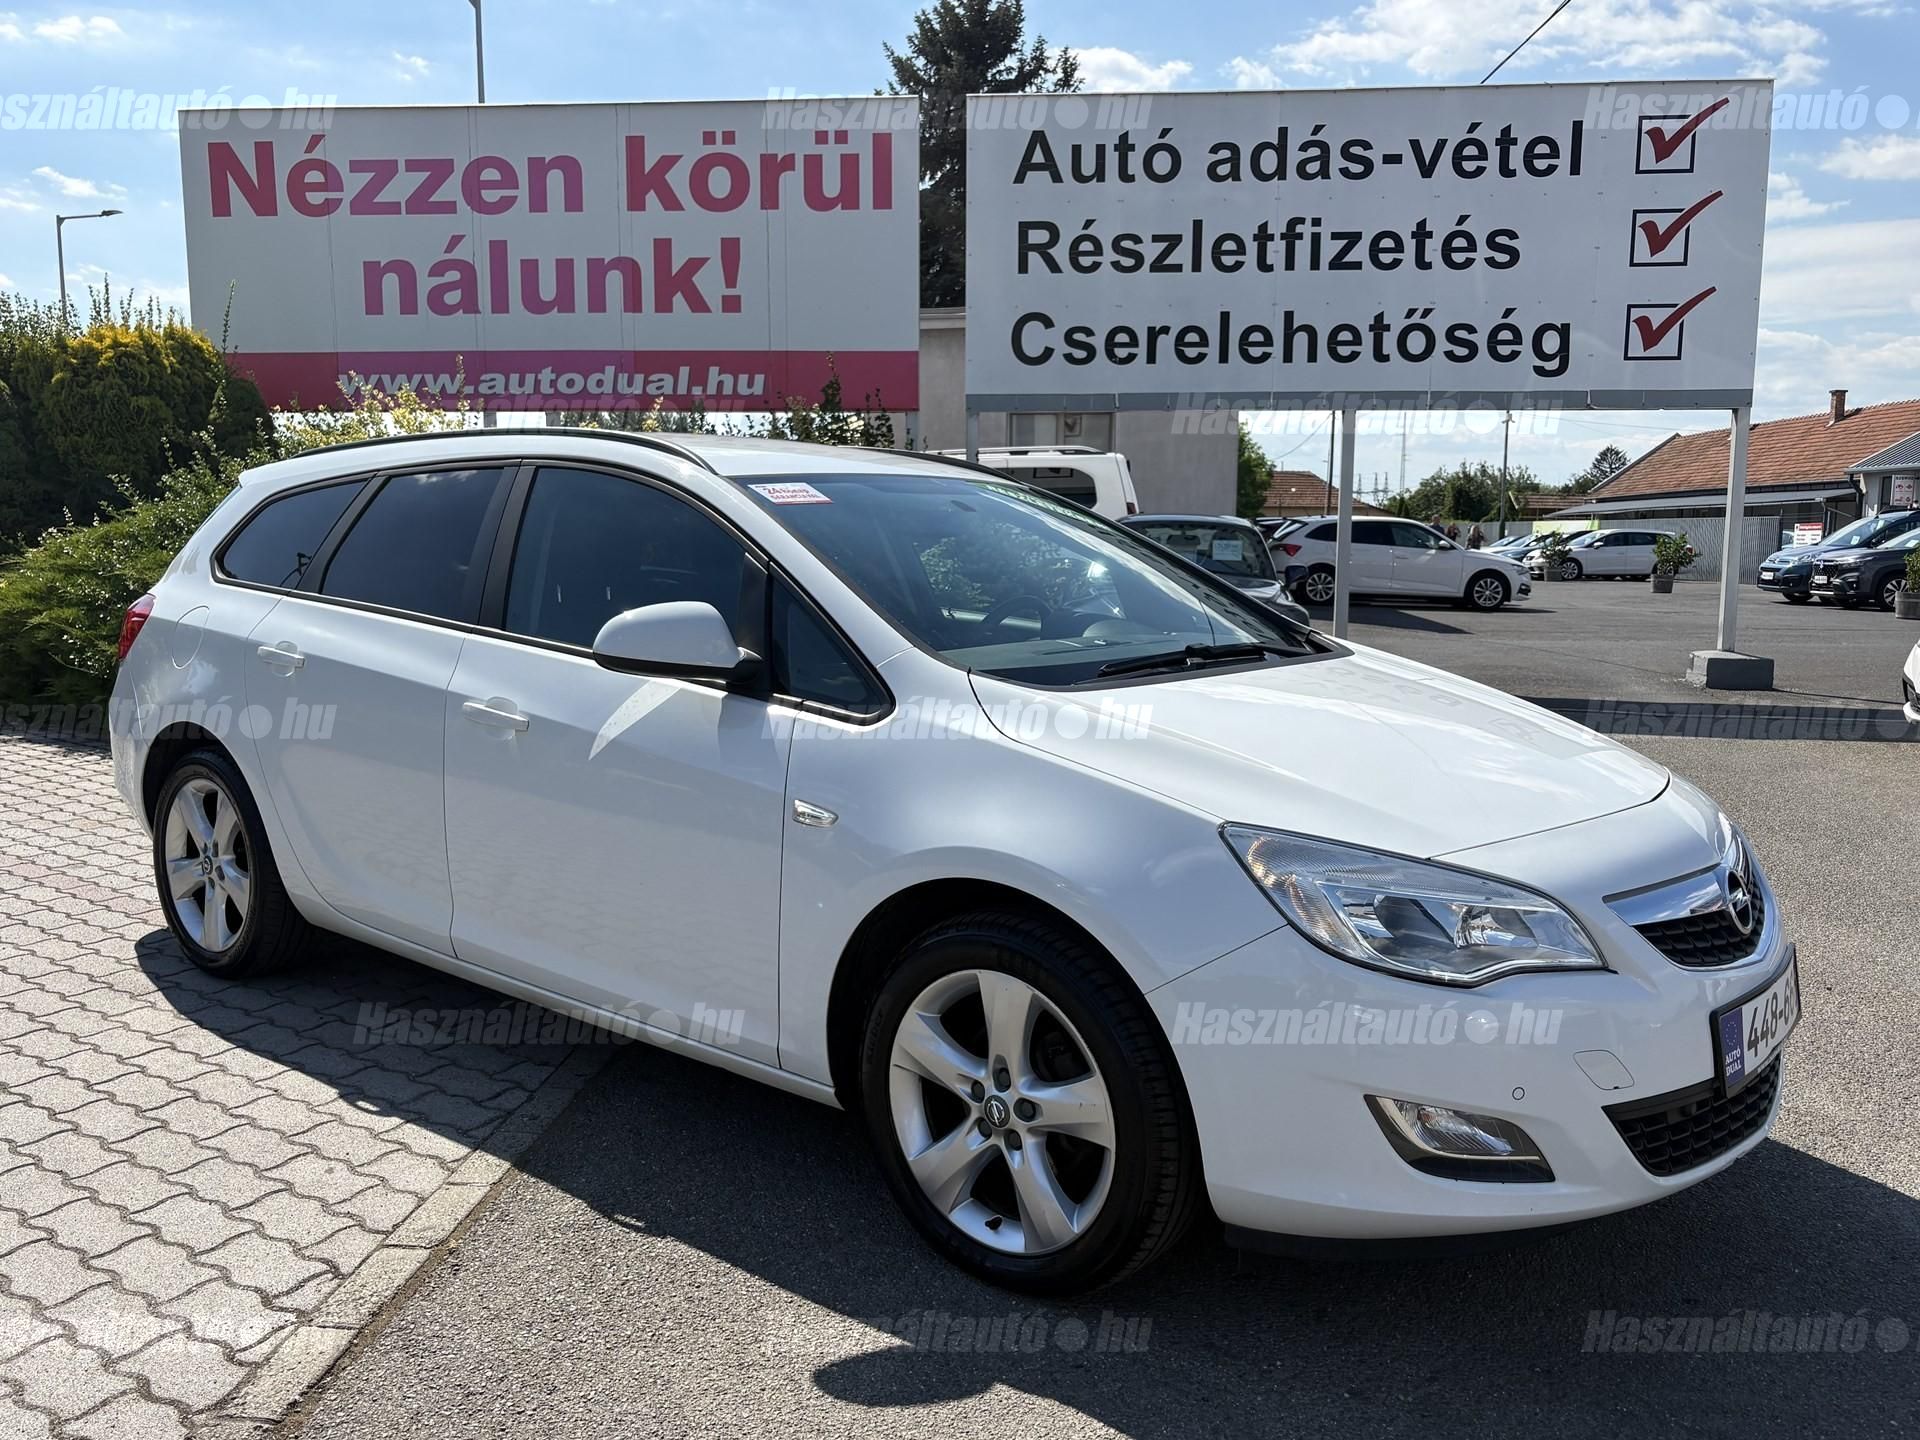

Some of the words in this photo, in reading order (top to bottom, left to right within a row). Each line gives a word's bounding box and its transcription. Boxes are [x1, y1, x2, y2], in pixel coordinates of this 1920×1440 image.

[207, 134, 584, 217] Nézzen
[625, 129, 894, 213] körül
[1013, 127, 1182, 184] Autó
[1206, 120, 1584, 182] adás-vétel
[362, 234, 742, 316] nálunk!
[1017, 214, 1521, 275] Részletfizetés
[1011, 307, 1571, 378] Cserelehetőség
[338, 366, 766, 397] www.autodual.hu
[1725, 1046, 1741, 1065] AUTÓ
[1725, 1060, 1742, 1078] DUAL
